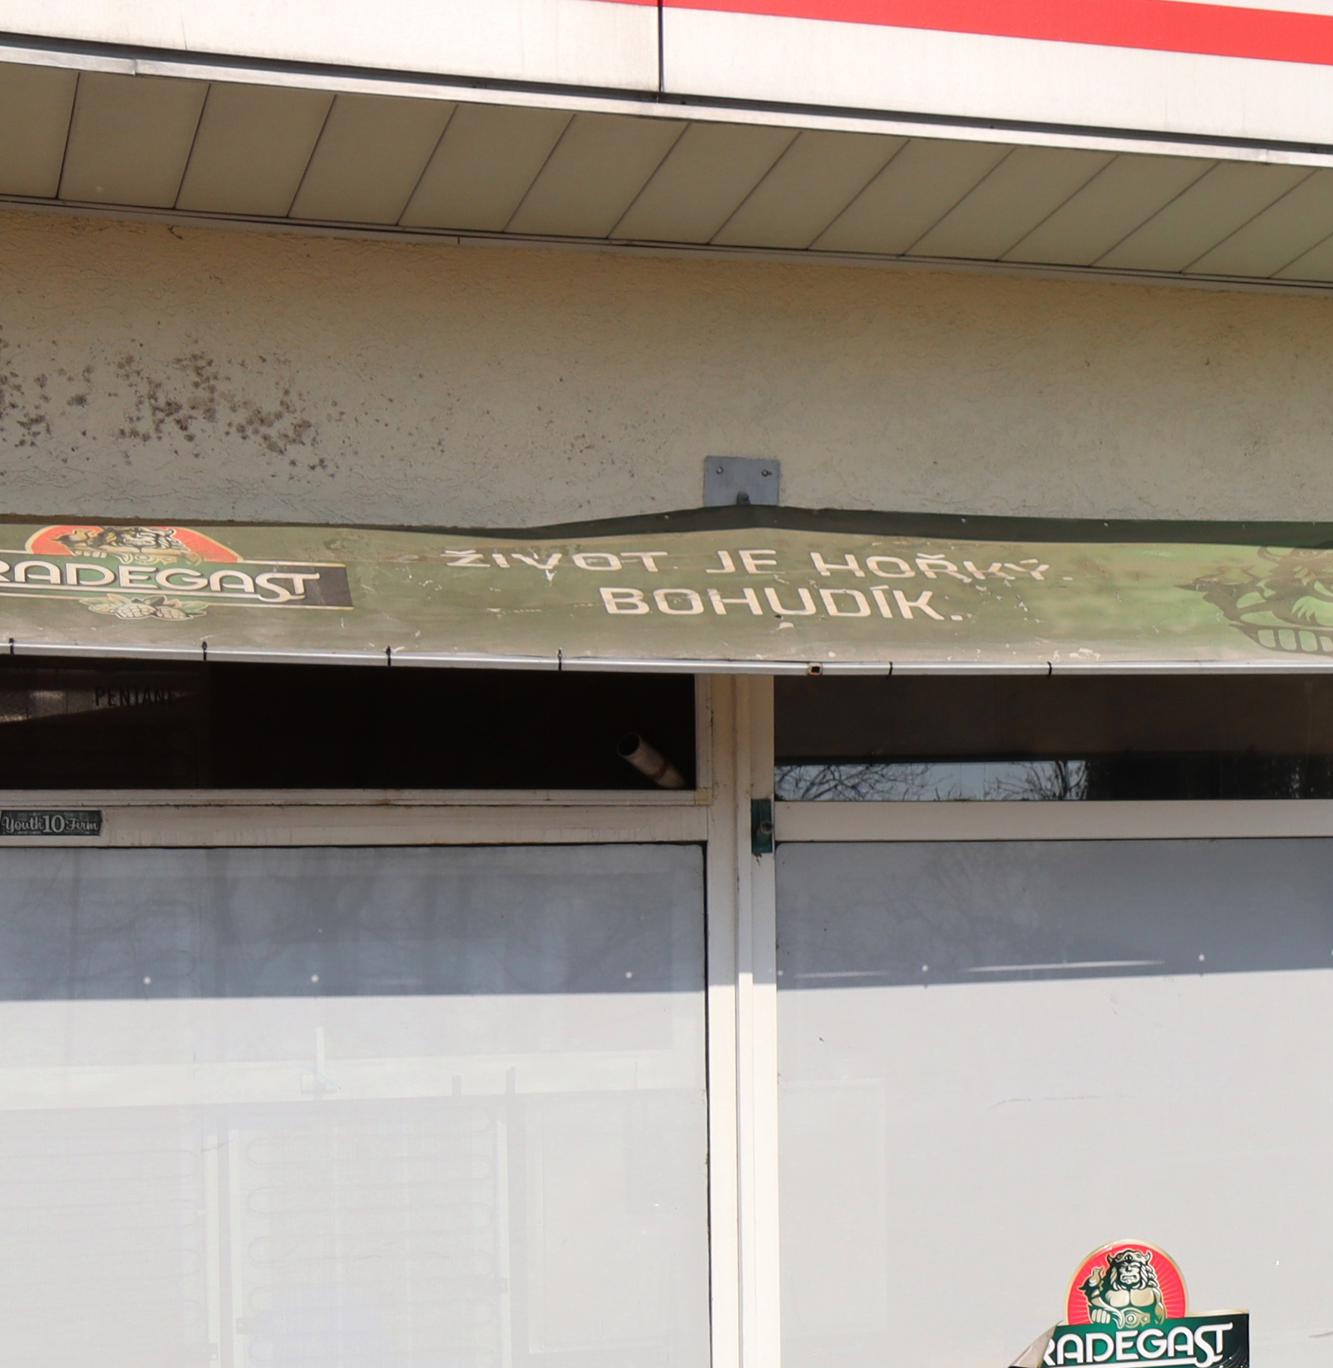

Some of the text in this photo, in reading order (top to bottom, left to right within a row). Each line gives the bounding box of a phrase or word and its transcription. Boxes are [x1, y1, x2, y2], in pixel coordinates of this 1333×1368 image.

[440, 550, 668, 572] ŽIVOT
[705, 550, 780, 574] JE
[0, 560, 320, 602] ADEGAST
[600, 585, 963, 621] BOHUDÍK.
[43, 815, 65, 833] 10
